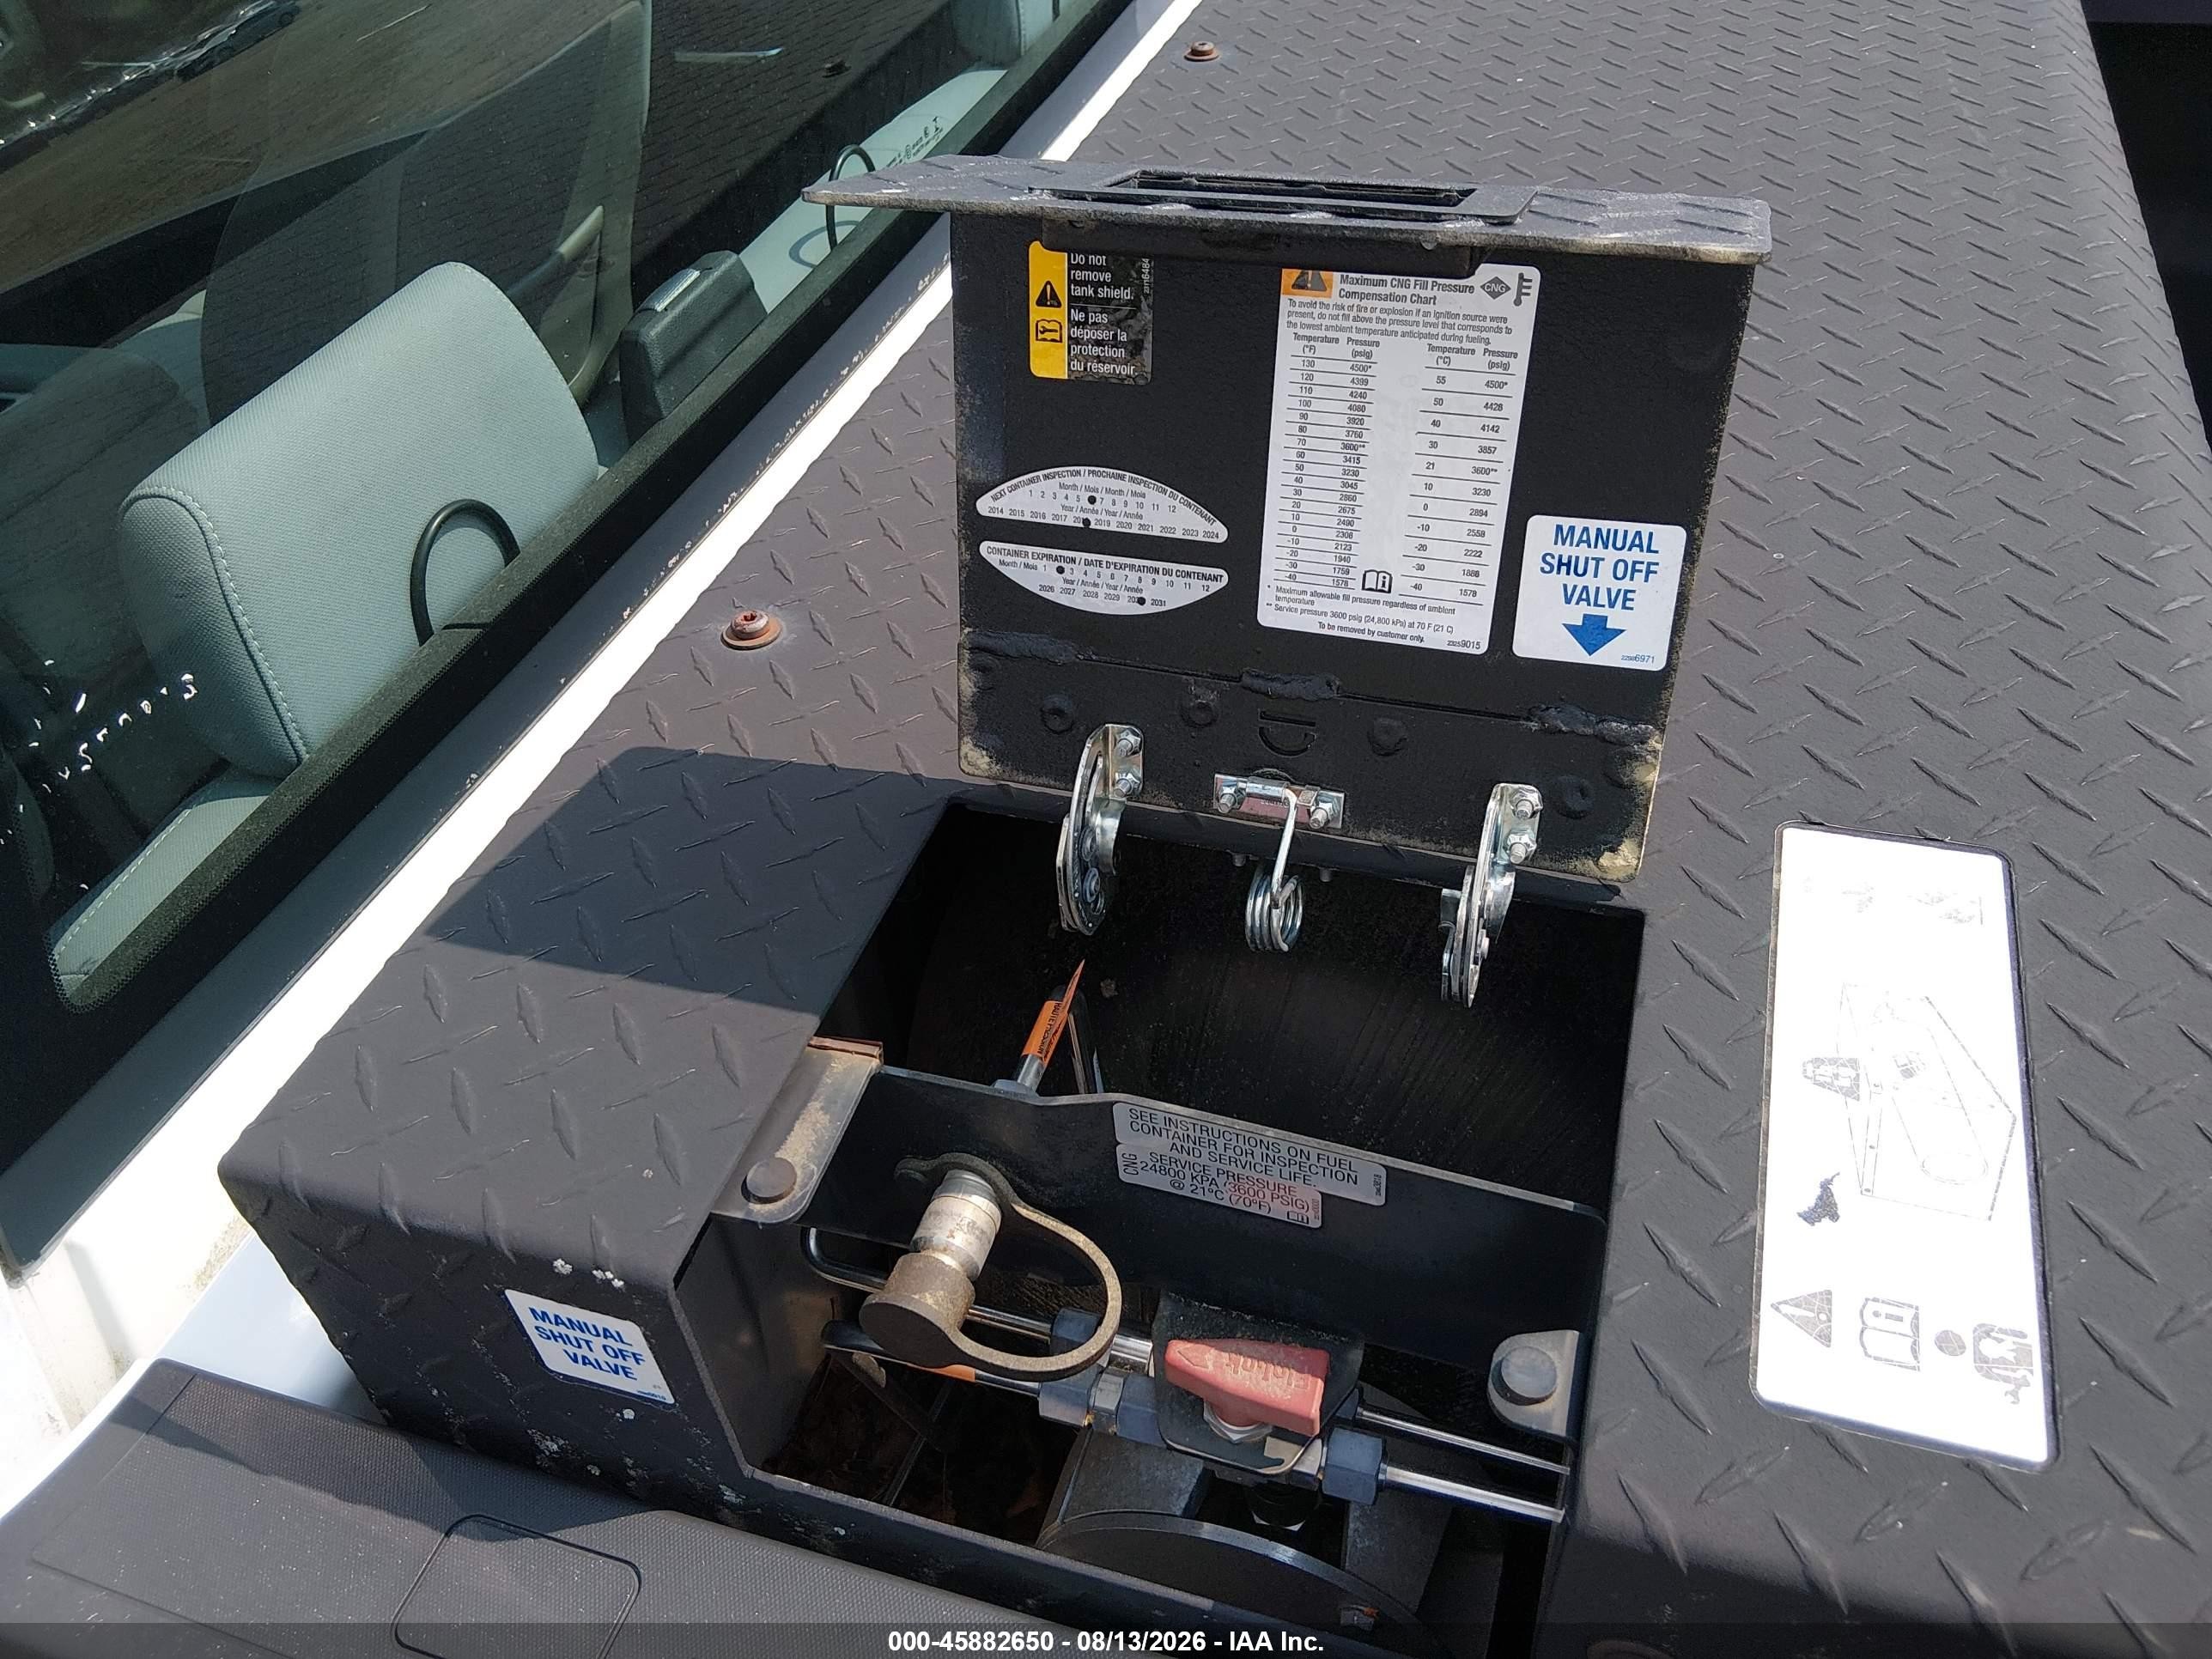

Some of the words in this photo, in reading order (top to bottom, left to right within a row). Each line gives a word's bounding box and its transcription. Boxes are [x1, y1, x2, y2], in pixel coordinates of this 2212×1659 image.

[1071, 252, 1085, 264] Do
[1089, 255, 1106, 265] not
[1071, 270, 1111, 282] remove
[1340, 274, 1388, 288] Maximum
[1390, 277, 1411, 289] CNG
[1413, 279, 1429, 290] Fill
[1431, 280, 1474, 294] Pressure
[1071, 283, 1094, 297] tank
[1097, 285, 1133, 300] shield.
[1339, 288, 1407, 303] Compensation
[1409, 293, 1437, 306] Chart
[1484, 283, 1506, 293] CNG
[1071, 308, 1085, 322] Ne
[1088, 309, 1108, 325] pas
[1287, 298, 1297, 307] To
[1297, 300, 1317, 309] avoid
[1318, 301, 1330, 310] the
[1332, 301, 1346, 311] risk
[1346, 303, 1354, 312] of
[1356, 304, 1368, 313] fire
[1379, 307, 1413, 316] explosion
[1415, 308, 1421, 317] if
[1433, 309, 1461, 320] ignition
[1462, 313, 1487, 322] source
[1489, 315, 1508, 324] were
[1287, 310, 1316, 320] present,
[1317, 311, 1327, 319] do
[1328, 313, 1340, 321] not
[1341, 313, 1350, 321] fill
[1352, 313, 1373, 324] above
[1375, 315, 1387, 325] the
[1388, 318, 1420, 327] pressure
[1421, 319, 1439, 329] level
[1441, 320, 1455, 330] that
[1457, 323, 1503, 334] corresponds
[1504, 325, 1512, 334] to
[1070, 325, 1115, 341] déposer
[1117, 328, 1127, 341] la
[1286, 319, 1297, 329] the
[1299, 321, 1322, 331] lowest
[1324, 324, 1353, 333] ambient
[1354, 325, 1399, 337] temperature
[1400, 330, 1439, 340] anticipated
[1440, 332, 1463, 343] during
[1465, 334, 1491, 346] fueling.
[1292, 331, 1340, 343] Temperature
[1346, 336, 1380, 348] Pressure
[1070, 343, 1125, 358] protection
[1302, 344, 1316, 355] (°F)
[1351, 348, 1373, 360] (psig)
[1426, 343, 1475, 356] Temperature
[1482, 348, 1518, 359] Pressure
[1070, 358, 1084, 371] du
[1087, 360, 1138, 375] réservoir.
[1436, 356, 1451, 367] (°C)
[1487, 360, 1510, 371] (psig)
[1431, 419, 1441, 428] 40
[1480, 423, 1500, 433] 4142
[1428, 440, 1438, 449] 30
[1477, 445, 1497, 454] 3857
[991, 489, 1006, 502] NEXT
[1007, 475, 1042, 493] CONTAINER
[1042, 470, 1081, 481] INSPECTION
[1088, 470, 1127, 482] PROCHAINE
[1128, 476, 1168, 495] INSPECTION
[1169, 491, 1179, 501] DU
[1179, 496, 1217, 526] CONTENANT
[1424, 482, 1433, 490] 10
[1472, 487, 1491, 496] 3230
[1423, 502, 1428, 511] 0
[1468, 507, 1488, 517] 2894
[988, 506, 1004, 514] 2014
[1008, 507, 1024, 517] 2015
[1030, 510, 1046, 520] 2016
[1051, 513, 1067, 522] 2017
[1094, 518, 1110, 527] 2019
[1115, 520, 1133, 529] 2020
[1137, 523, 1153, 532] 2021
[1159, 526, 1176, 534] 2022
[1182, 527, 1199, 537] 2023
[1202, 530, 1218, 539] 2024
[1553, 524, 1659, 554] MANUAL
[1463, 549, 1483, 558] 2222
[987, 545, 1029, 559] CONTAINER
[1031, 551, 1076, 565] EXPIRATION
[1084, 558, 1103, 568] DATE
[1105, 560, 1160, 575] D'EXPIRATION
[1162, 567, 1173, 577] DU
[1175, 569, 1224, 583] CONTENANT
[1540, 552, 1605, 578] SHUT
[1612, 558, 1659, 582] OFF
[1459, 588, 1477, 598] 1578
[1562, 583, 1637, 611] VALVE
[1336, 625, 1365, 635] removed
[1367, 628, 1375, 637] by
[1376, 630, 1408, 640] customer
[1409, 634, 1425, 643] only.
[1128, 1108, 1158, 1125] SEE
[1164, 1115, 1280, 1153] INSTRUCTIONS
[1287, 1146, 1310, 1161] ON
[1316, 1152, 1358, 1173] FUEL
[1130, 1120, 1218, 1151] CONTAINER
[1224, 1142, 1255, 1160] FOR
[1261, 1152, 1358, 1185] INSPECTION
[1121, 1152, 1139, 1176] CNG
[1170, 1142, 1201, 1158] AND
[1207, 1151, 1273, 1176] SERVICE
[1279, 1168, 1316, 1187] LIFE.
[1149, 1152, 1212, 1176] SERVICE
[1216, 1167, 1297, 1197] PRESSURE
[1139, 1160, 1186, 1180] 24800
[1190, 1172, 1219, 1188] KPA
[1223, 1180, 1265, 1200] (3600
[1271, 1192, 1310, 1212] PSIG)
[528, 1307, 633, 1346] MANUAL
[534, 1325, 593, 1352] SHUT
[602, 1344, 645, 1365] OFF
[562, 1349, 637, 1381] VALVE
